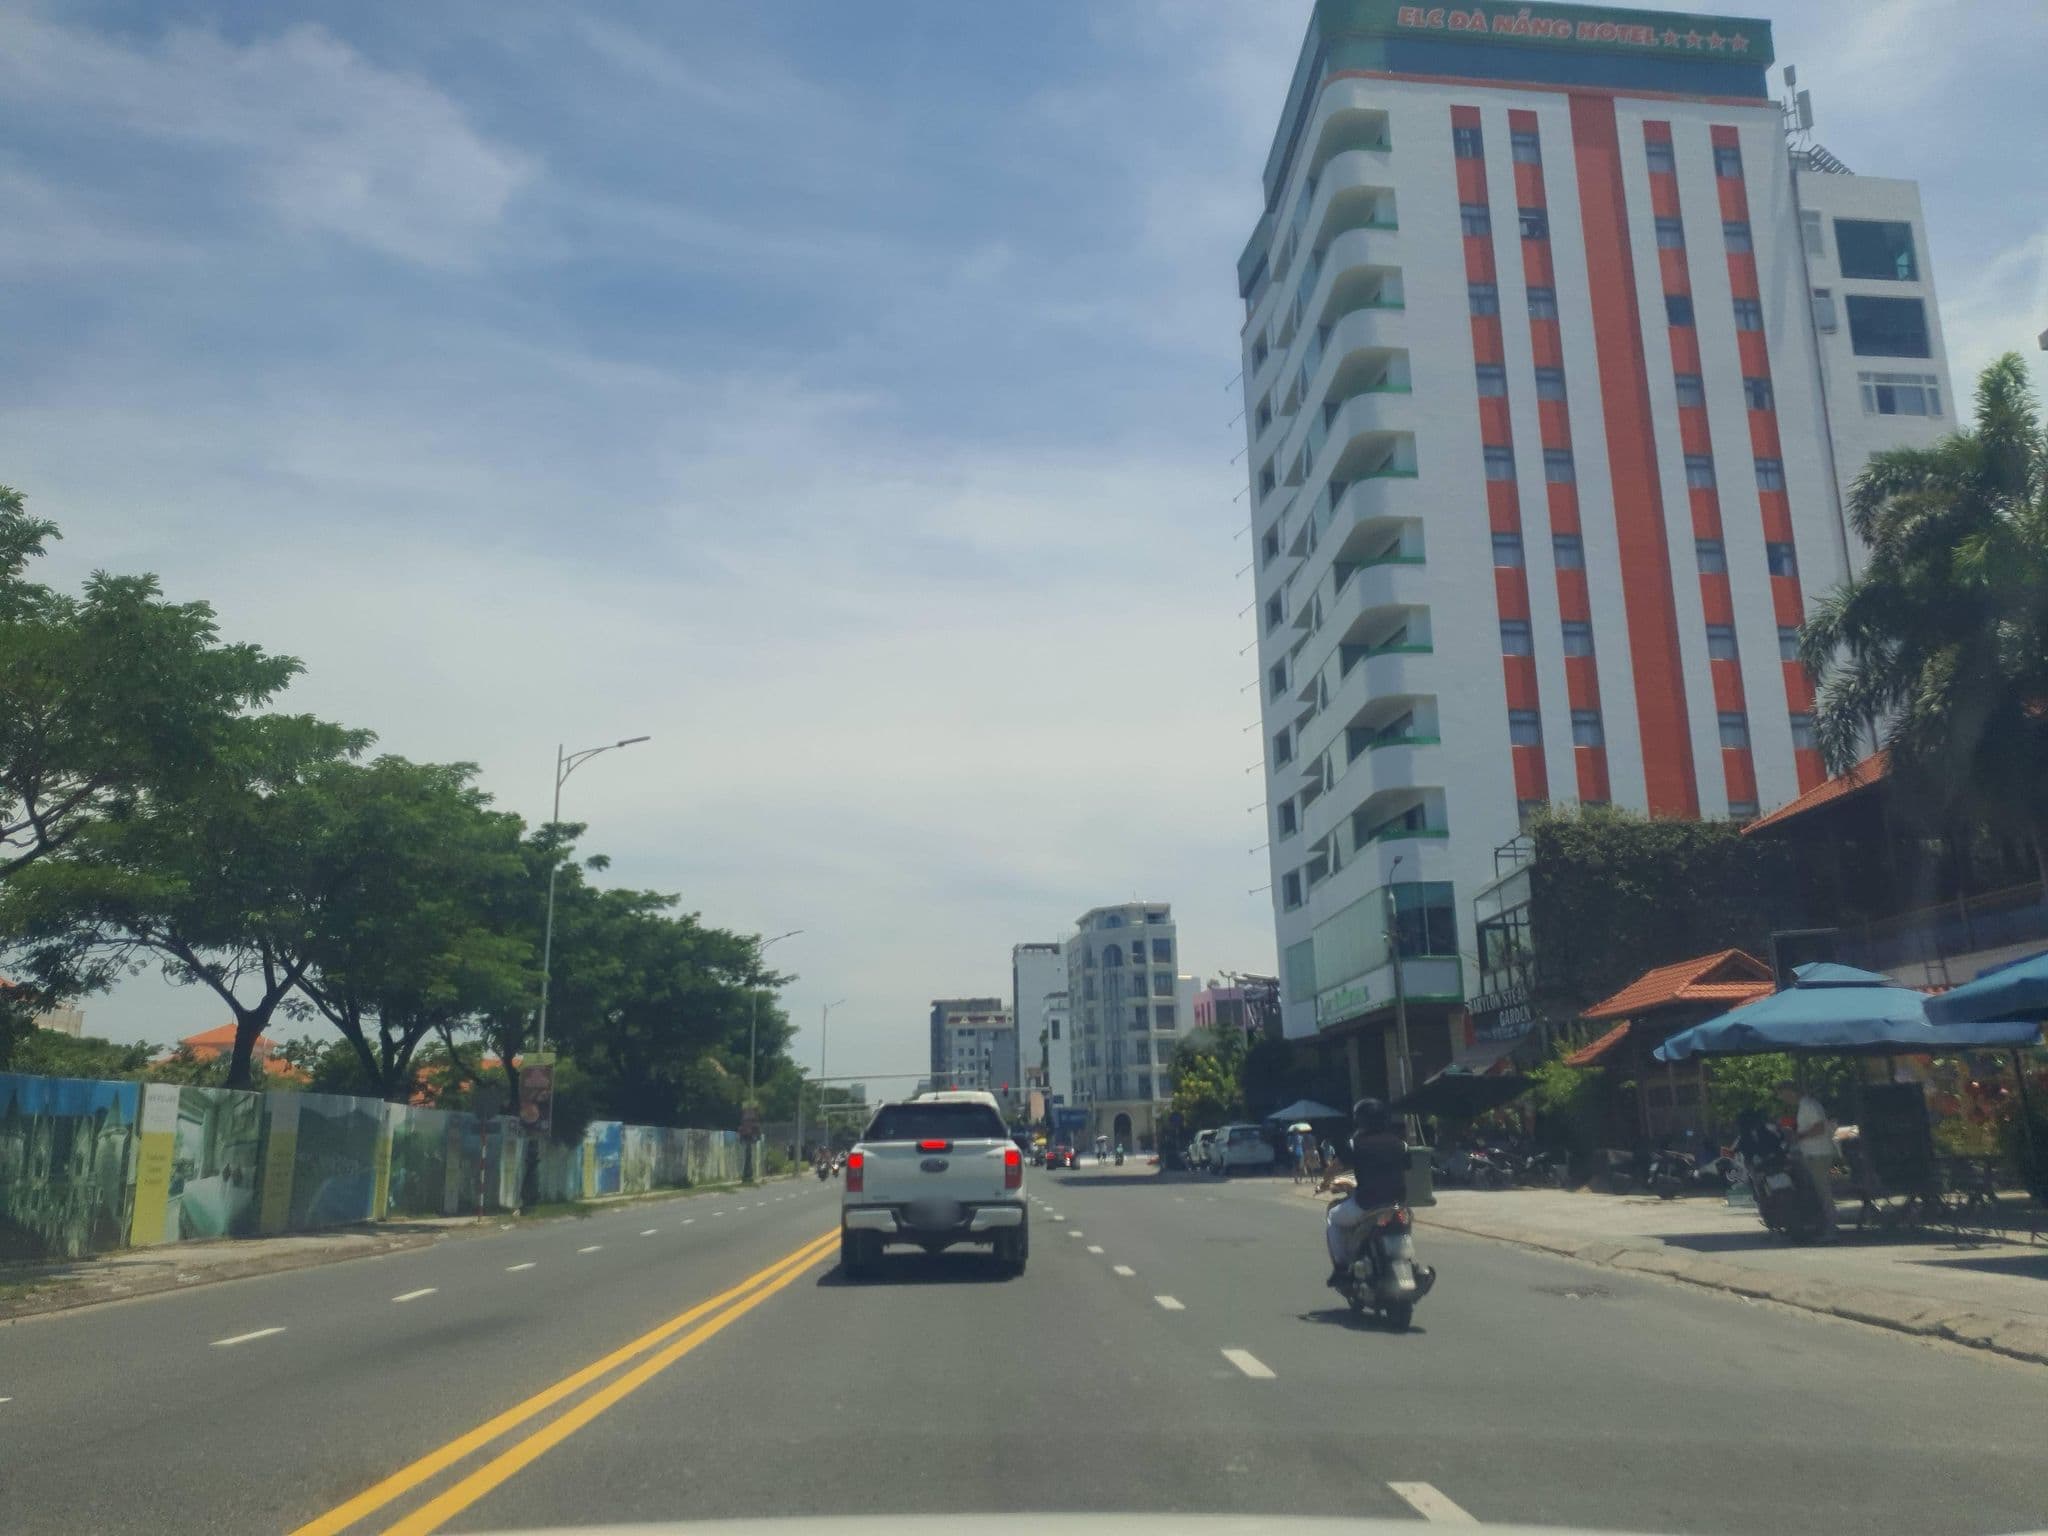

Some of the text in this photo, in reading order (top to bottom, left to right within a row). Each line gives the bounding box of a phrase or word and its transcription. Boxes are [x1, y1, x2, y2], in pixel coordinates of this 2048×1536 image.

[1398, 6, 1445, 29] ELC
[1577, 20, 1657, 45] HOTEL
[1499, 1006, 1531, 1026] GARDEN
